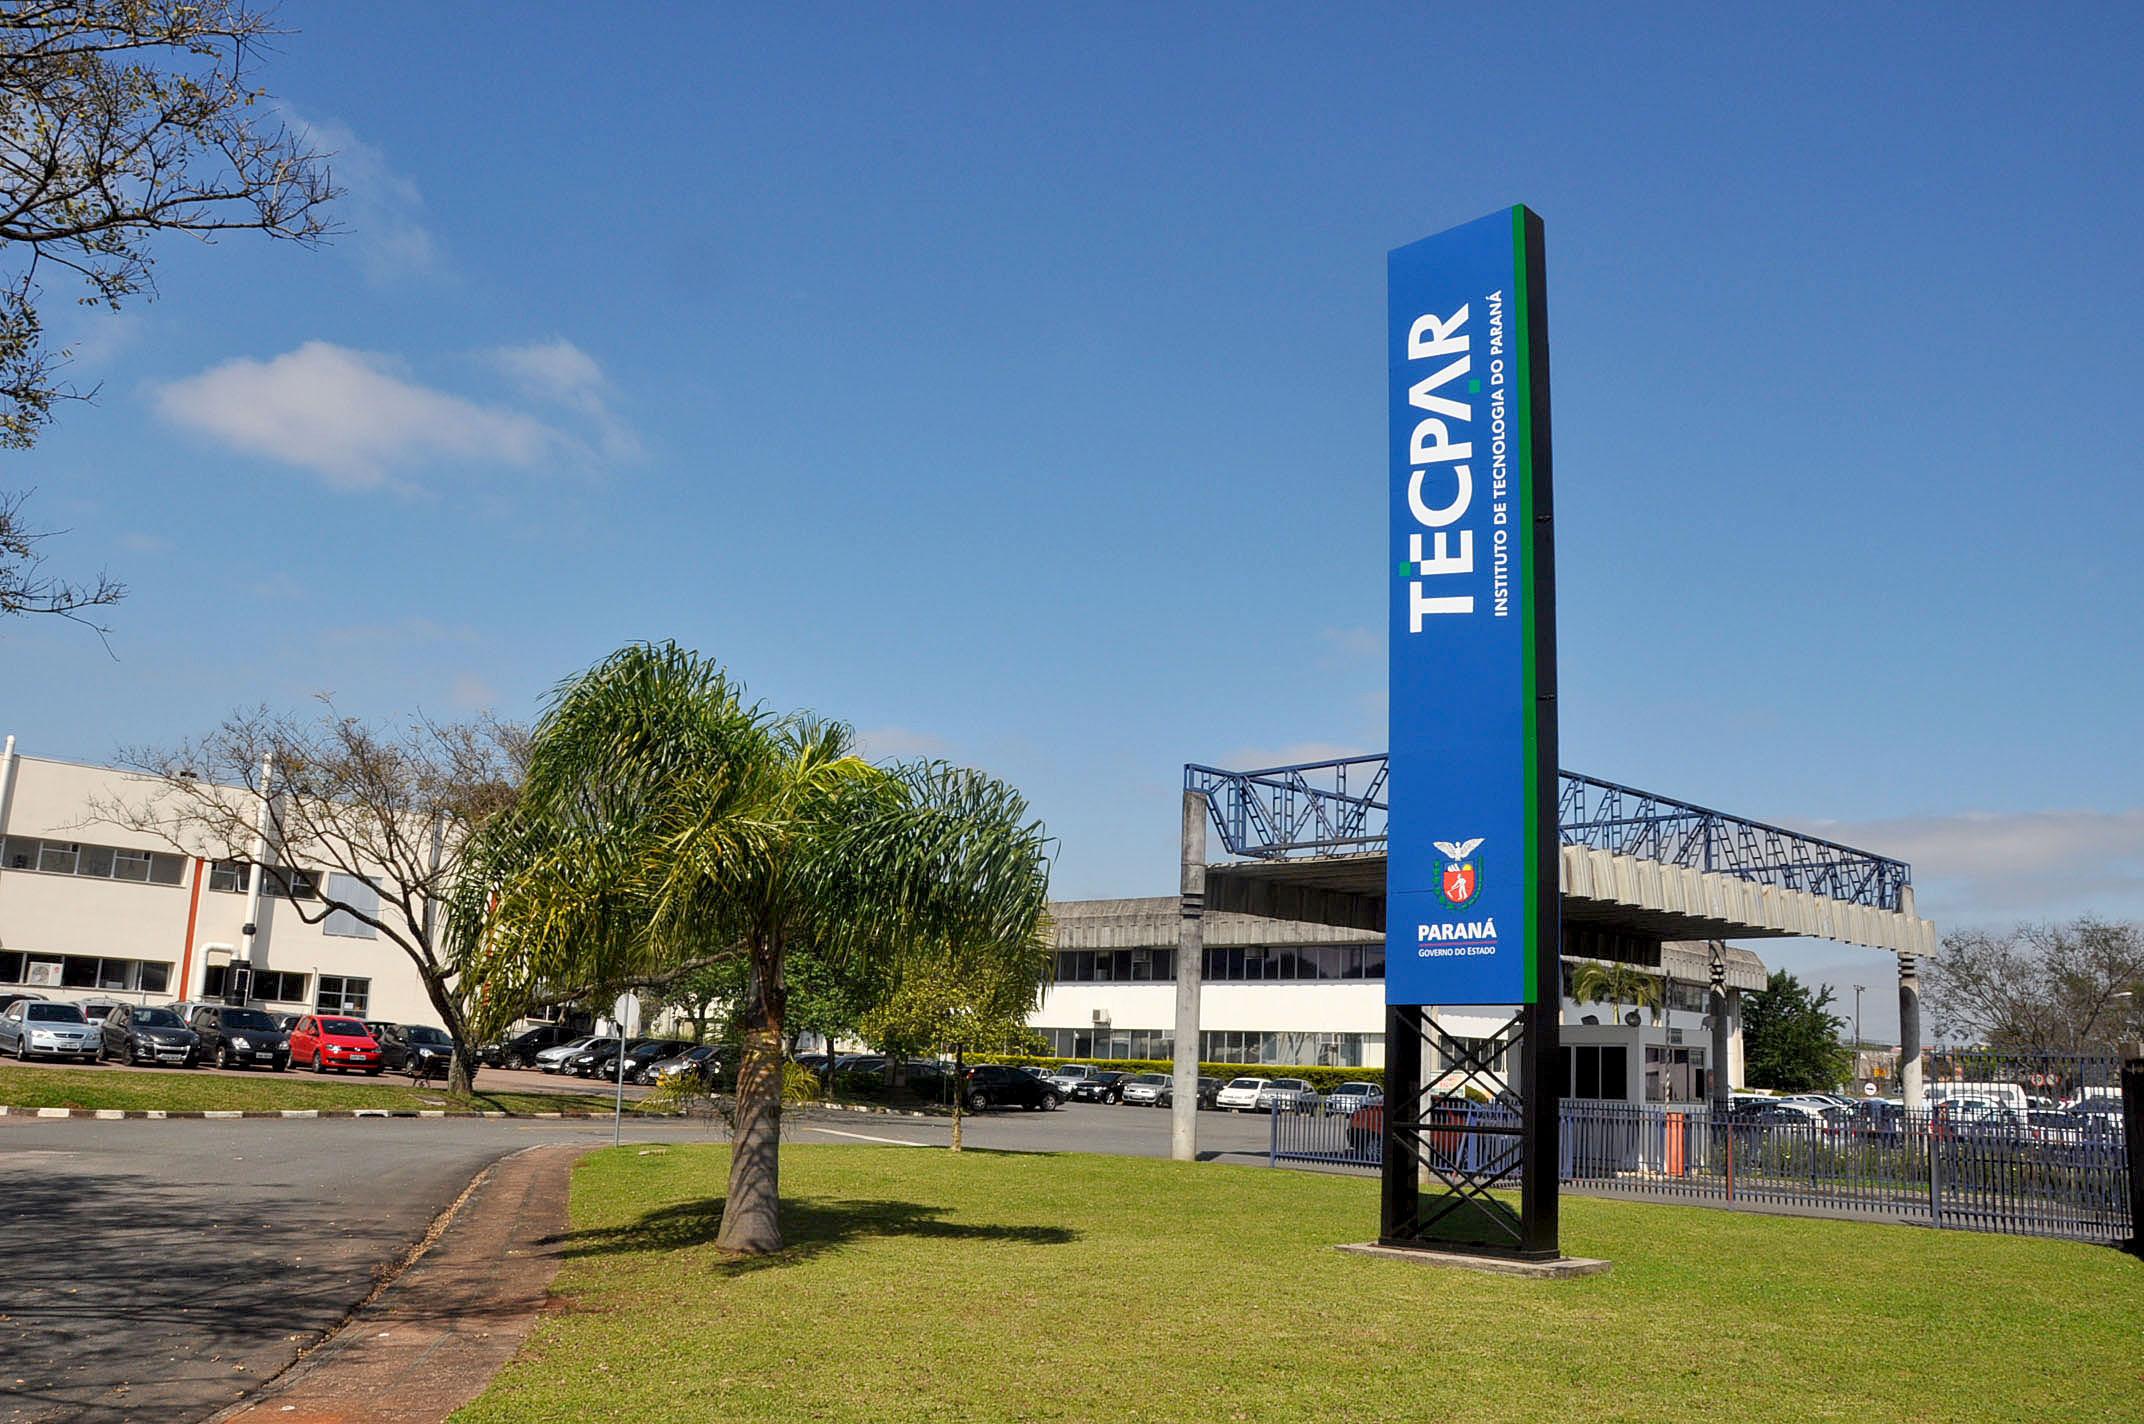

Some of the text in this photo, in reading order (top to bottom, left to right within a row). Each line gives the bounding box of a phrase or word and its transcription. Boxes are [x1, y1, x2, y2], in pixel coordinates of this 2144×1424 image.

[1408, 303, 1474, 633] TECPAR
[1486, 290, 1508, 616] INSTITUTO DE TECNOLOGIA DO PARANÁ
[1418, 918, 1497, 941] PARANÁ
[1418, 946, 1496, 957] GOVERNO DO ESTADO
